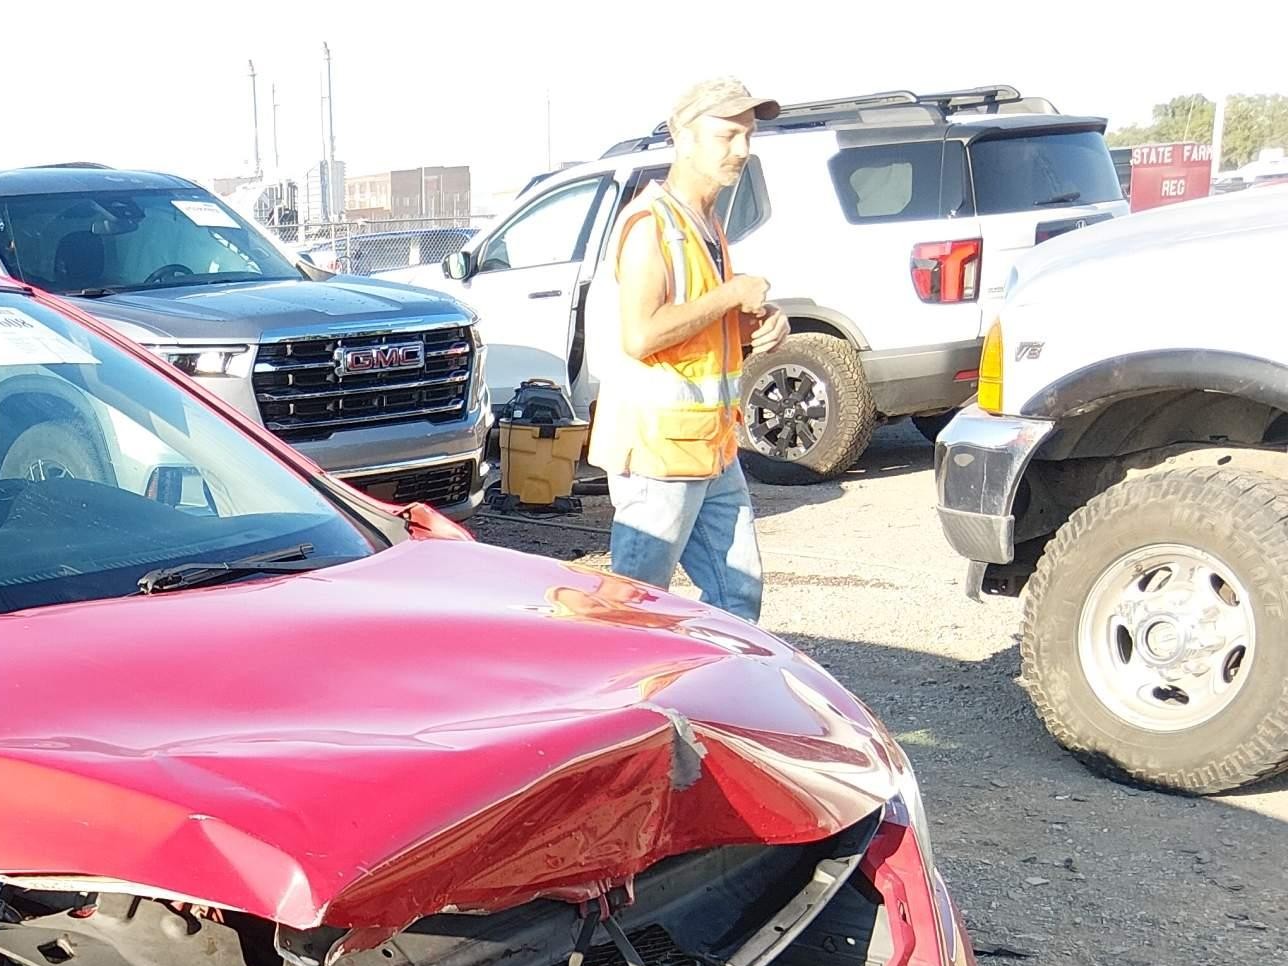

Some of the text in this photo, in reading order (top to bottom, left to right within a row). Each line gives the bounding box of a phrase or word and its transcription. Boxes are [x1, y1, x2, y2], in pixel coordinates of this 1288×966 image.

[1132, 147, 1173, 165] STATE
[1161, 179, 1185, 197] REG
[346, 345, 421, 371] GMC
[1014, 341, 1046, 362] V8
